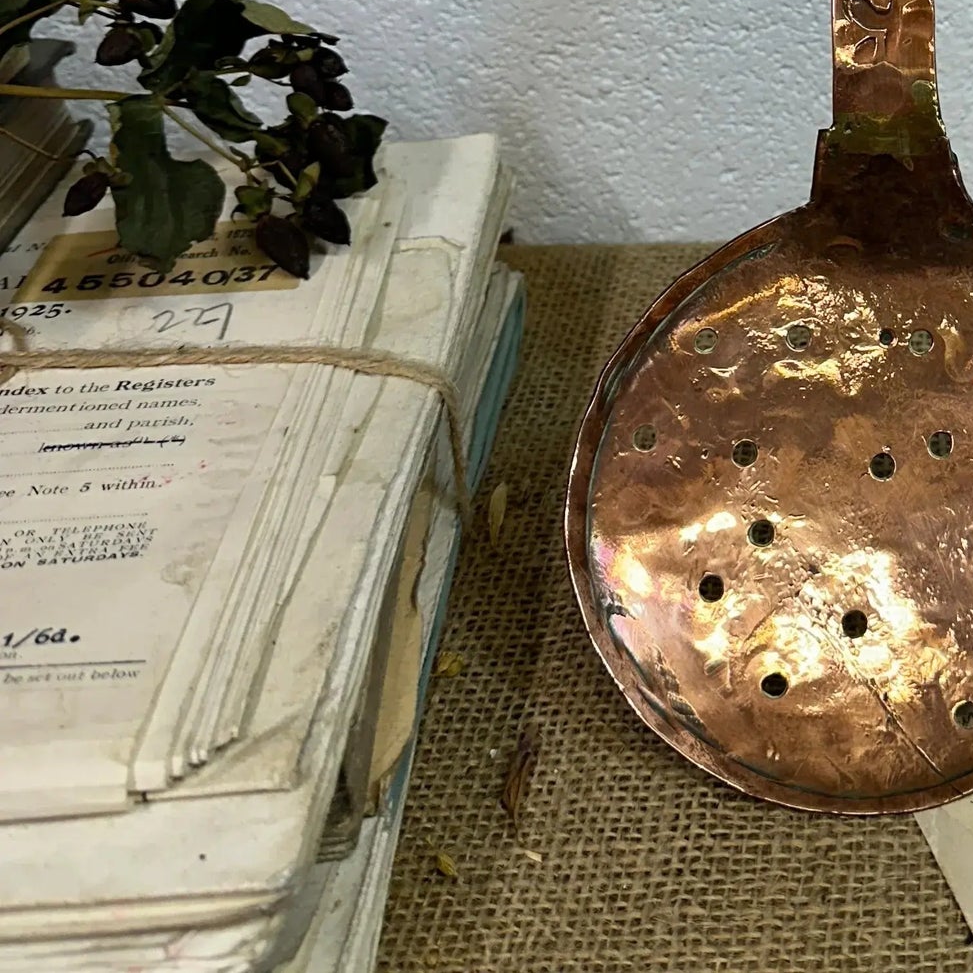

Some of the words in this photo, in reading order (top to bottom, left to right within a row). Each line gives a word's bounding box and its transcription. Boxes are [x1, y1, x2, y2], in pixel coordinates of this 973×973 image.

[228, 244, 252, 257] No.
[0, 303, 73, 320] 1925.
[54, 383, 75, 395] to
[79, 381, 111, 394] the
[113, 375, 217, 393] Registers
[136, 397, 203, 411] names,
[83, 418, 123, 431] and
[27, 484, 70, 498] Note
[79, 481, 93, 494] 5
[101, 476, 163, 493] within.
[13, 528, 37, 539] OR
[52, 521, 148, 536] TELEPHONE
[24, 533, 70, 546] ONLY
[82, 531, 105, 542] BE
[117, 527, 159, 539] SENT
[37, 550, 144, 567] SATURDAYS.
[3, 672, 24, 685] be
[91, 667, 141, 682] below
